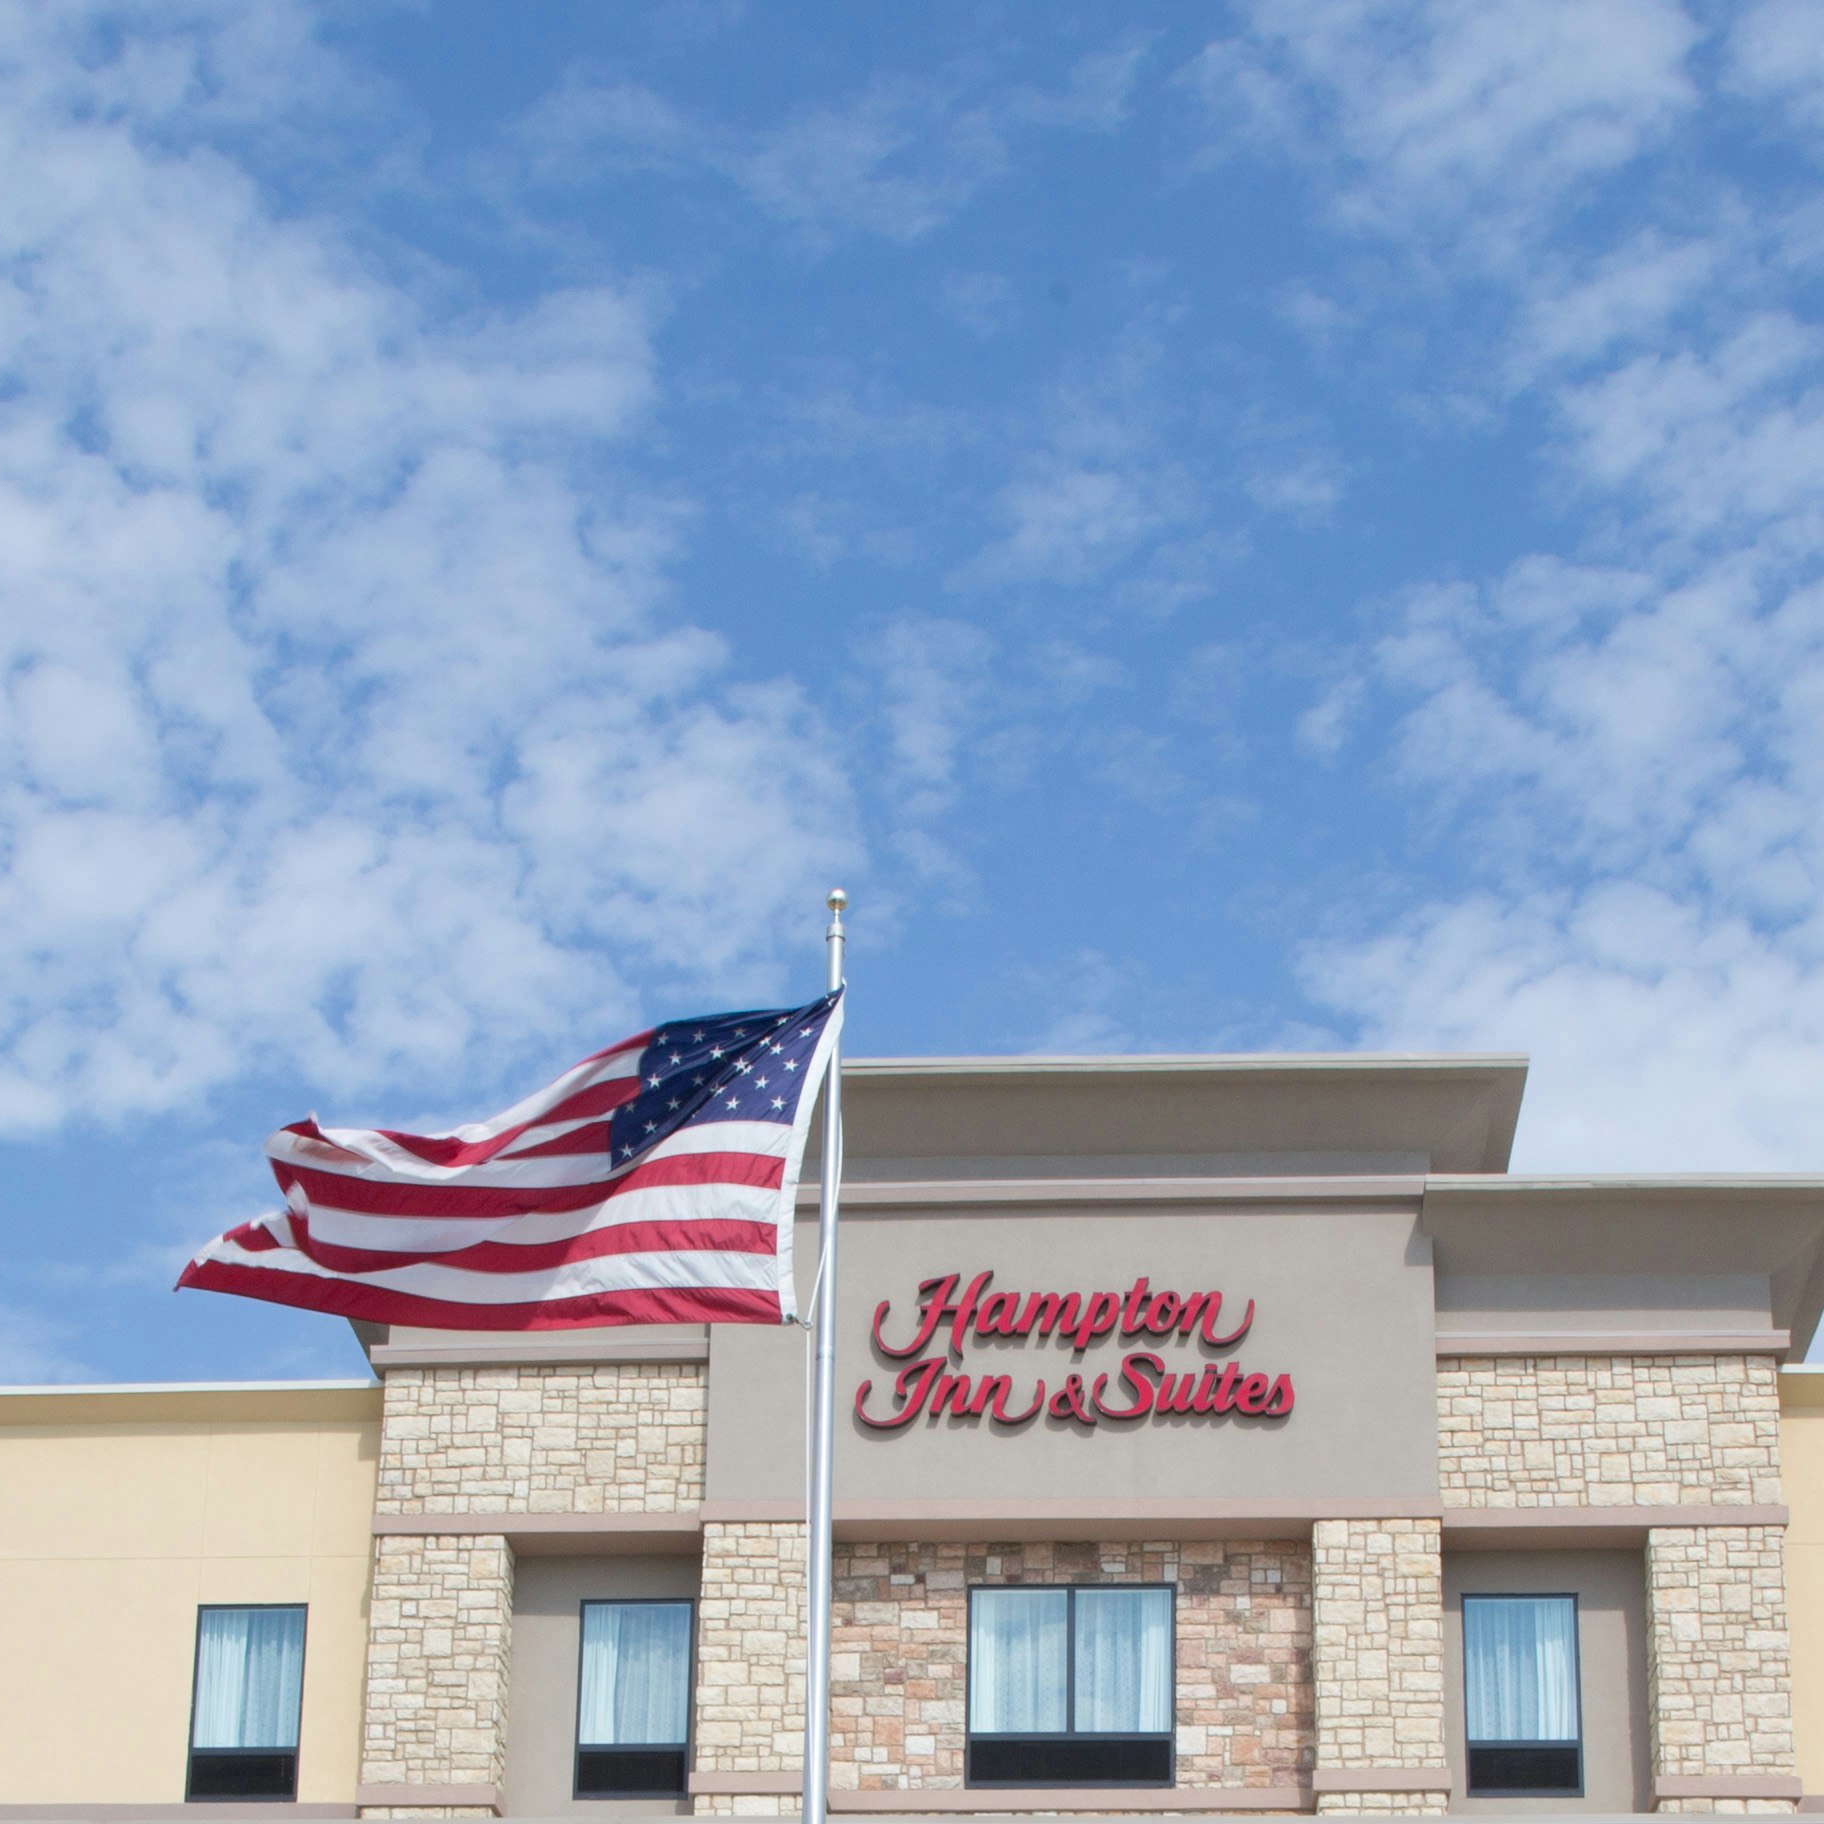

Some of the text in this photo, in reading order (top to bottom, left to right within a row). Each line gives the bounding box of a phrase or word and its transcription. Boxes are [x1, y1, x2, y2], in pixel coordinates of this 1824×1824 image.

[873, 1270, 1256, 1358] Hampton
[854, 1352, 1296, 1427] Inn & Suites
